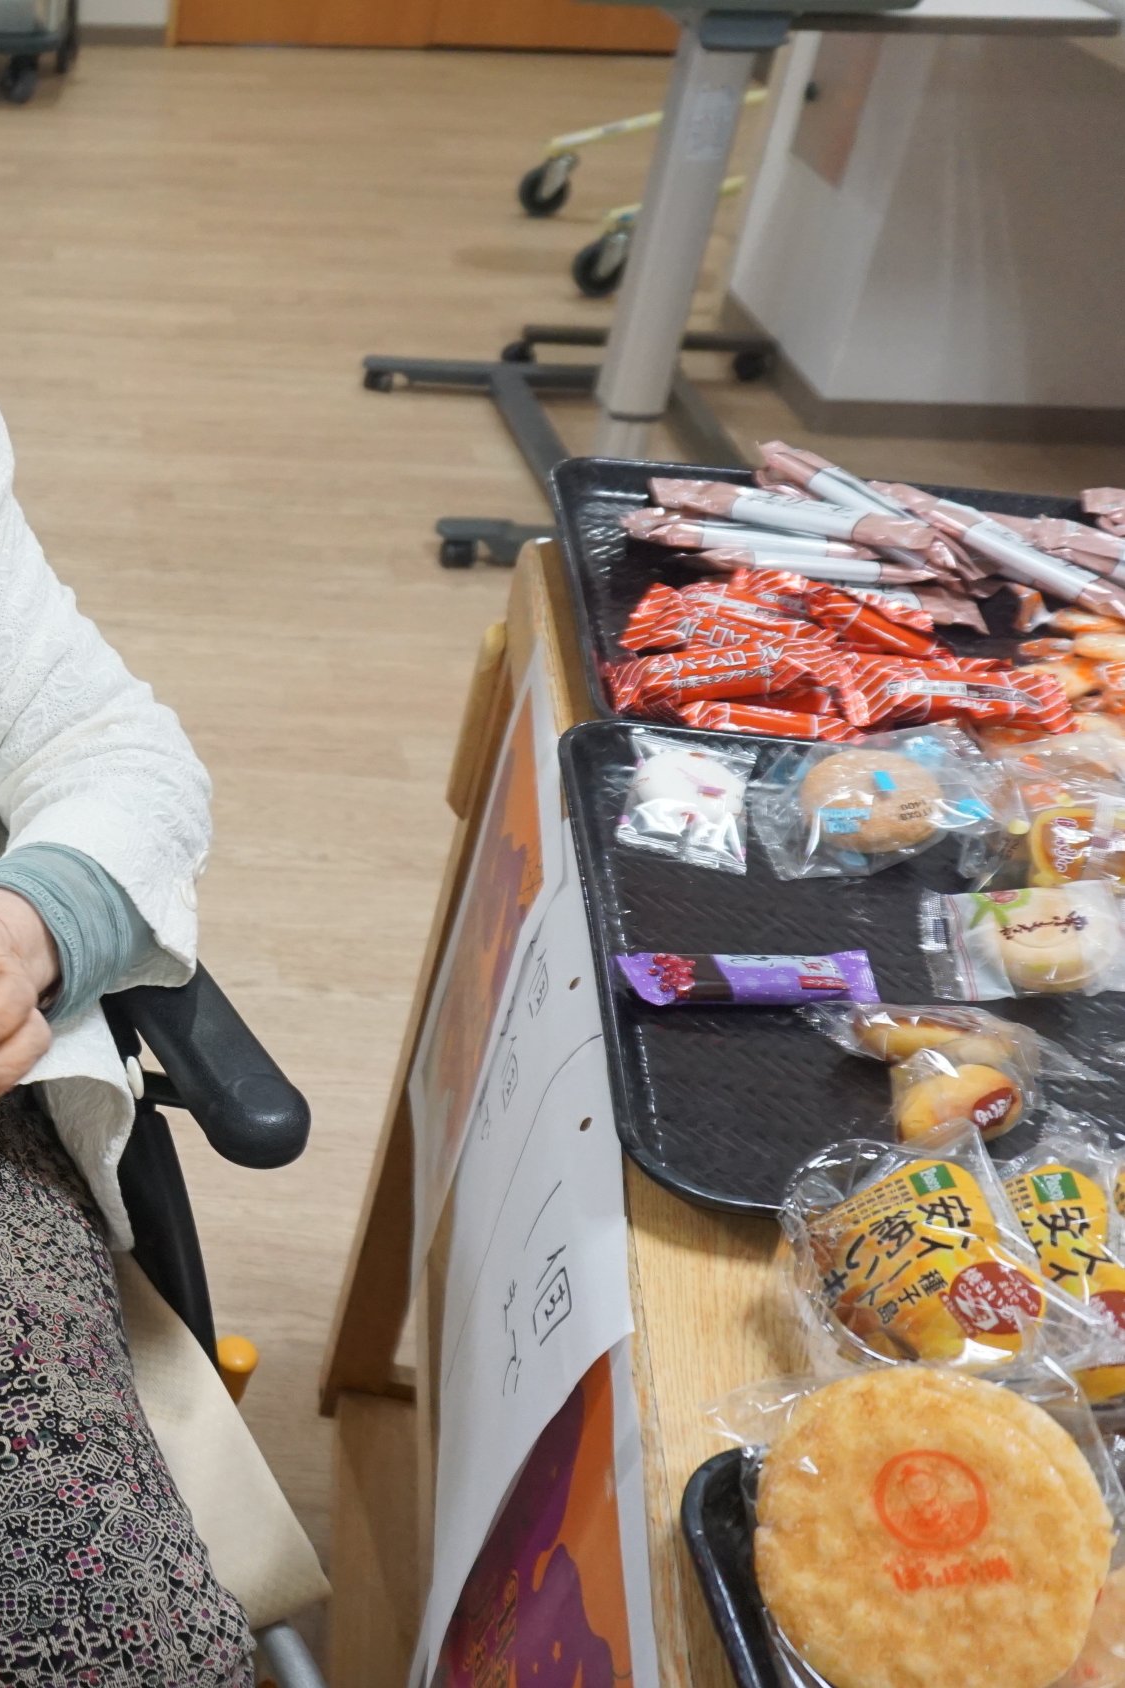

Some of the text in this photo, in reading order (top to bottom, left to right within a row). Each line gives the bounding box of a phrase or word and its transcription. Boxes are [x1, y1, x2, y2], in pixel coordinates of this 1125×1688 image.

[856, 1231, 984, 1307] イート
[877, 1269, 949, 1325] 種子島
